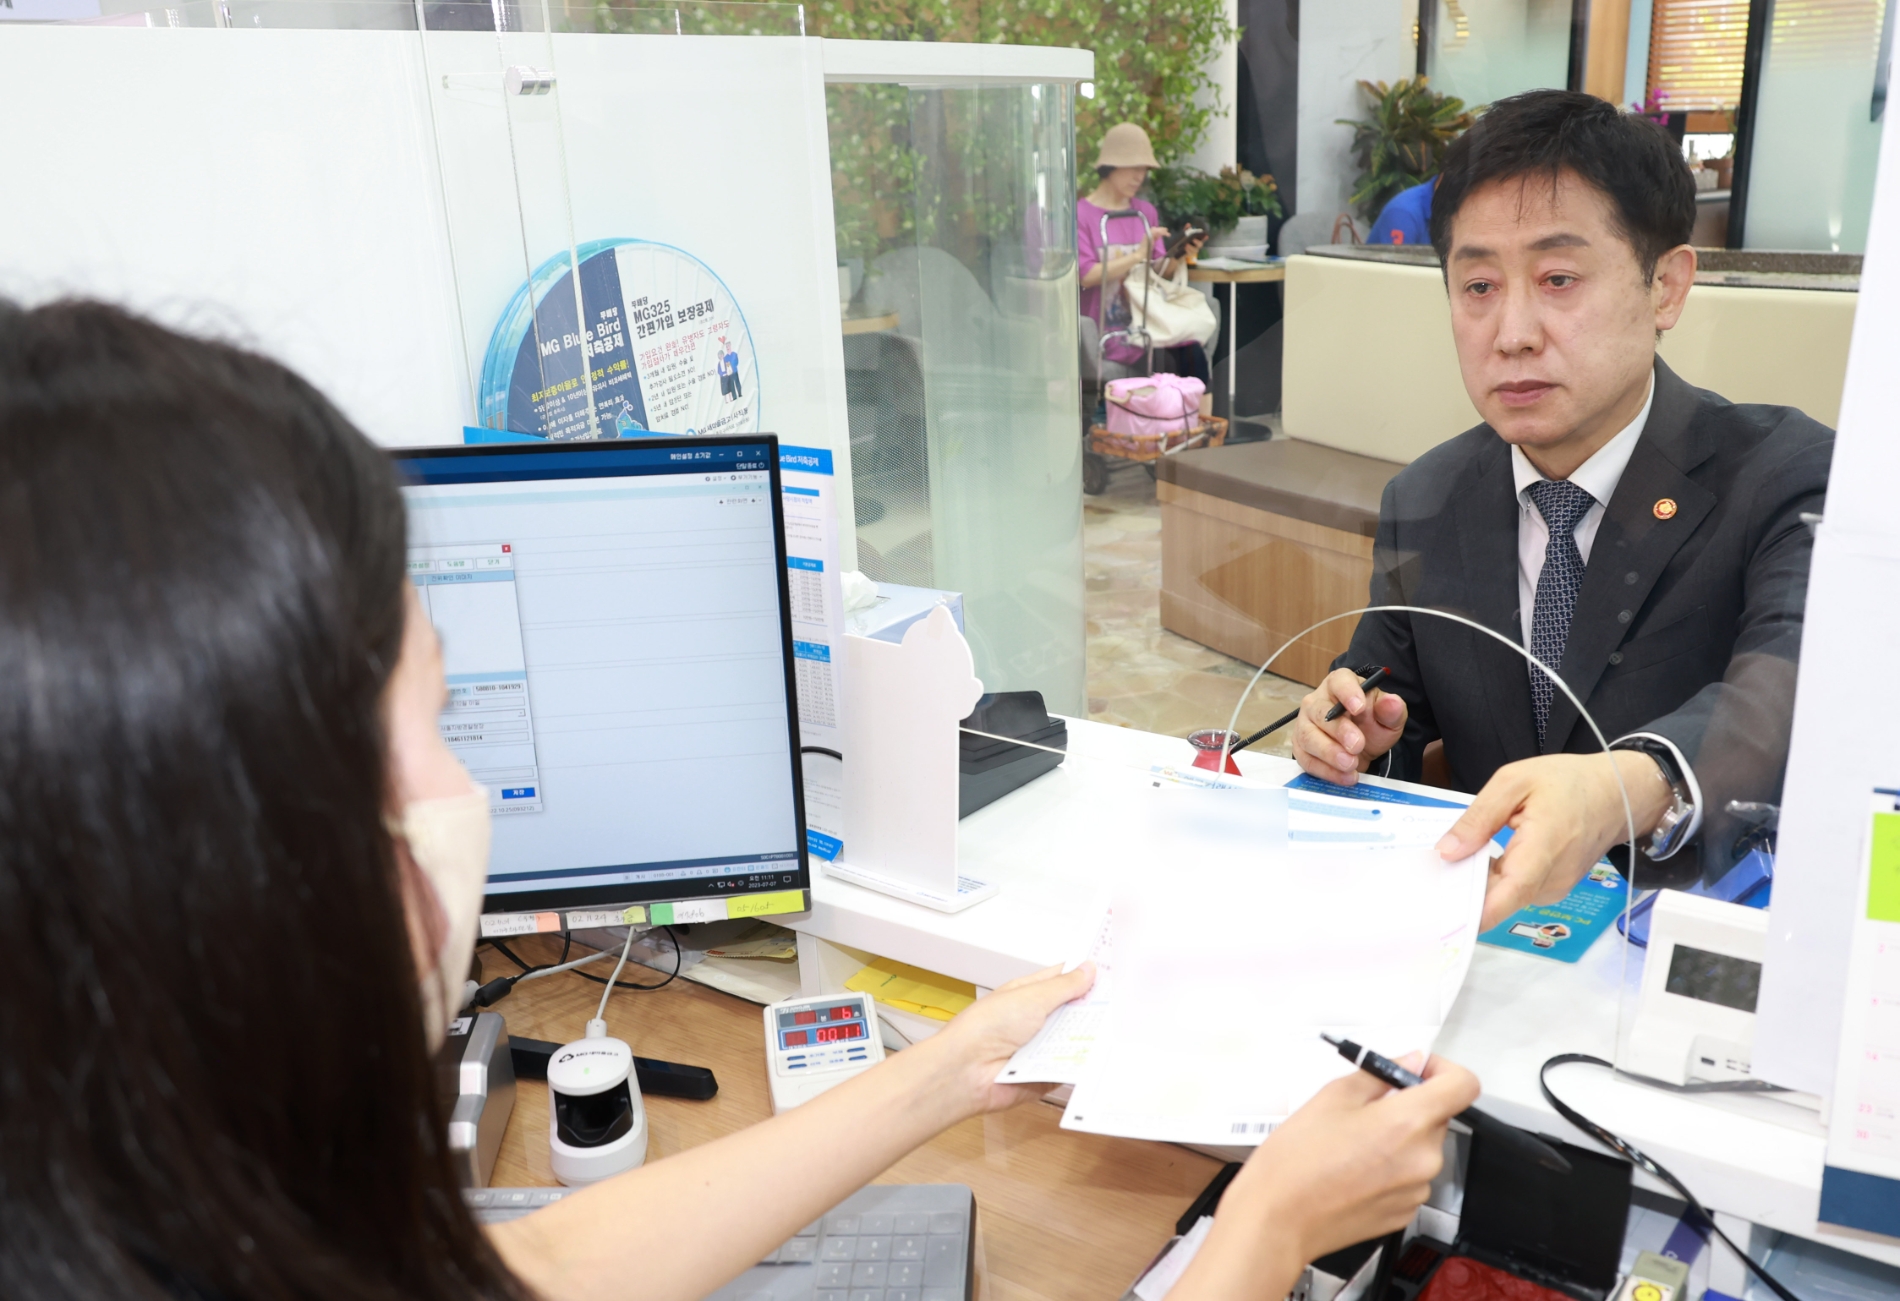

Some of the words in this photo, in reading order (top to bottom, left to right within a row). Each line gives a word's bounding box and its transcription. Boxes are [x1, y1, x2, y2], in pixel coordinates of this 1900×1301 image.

[633, 299, 671, 325] MG325
[636, 314, 674, 340] 간편가입
[677, 298, 714, 324] 보장공제
[541, 339, 560, 357] MG
[596, 318, 621, 337] Bird
[748, 881, 776, 889] 2023-07-07
